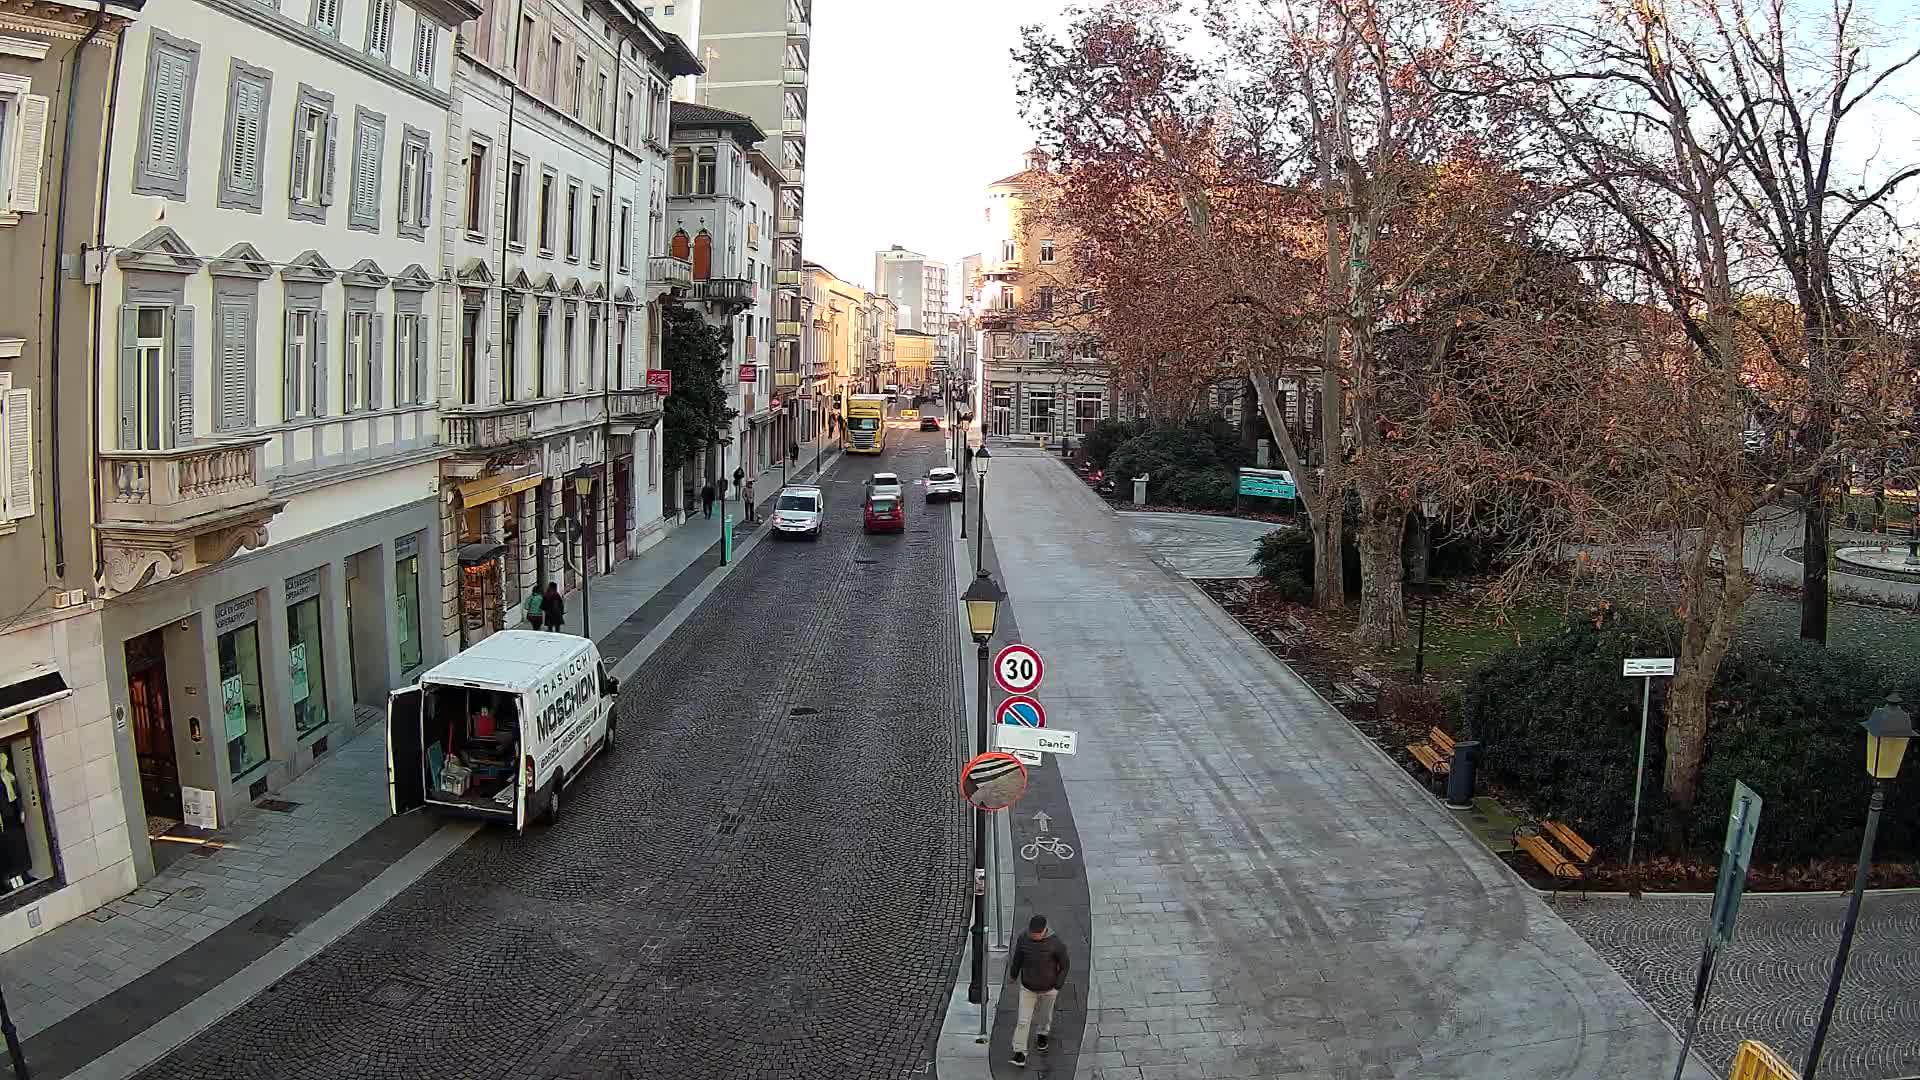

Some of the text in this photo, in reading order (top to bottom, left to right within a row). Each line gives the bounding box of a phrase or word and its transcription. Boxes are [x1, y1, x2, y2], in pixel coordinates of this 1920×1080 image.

[536, 651, 591, 701] TRASLOCHI
[1006, 658, 1033, 680] 30
[536, 670, 596, 744] MOSCHION
[1038, 738, 1070, 749] Dante
